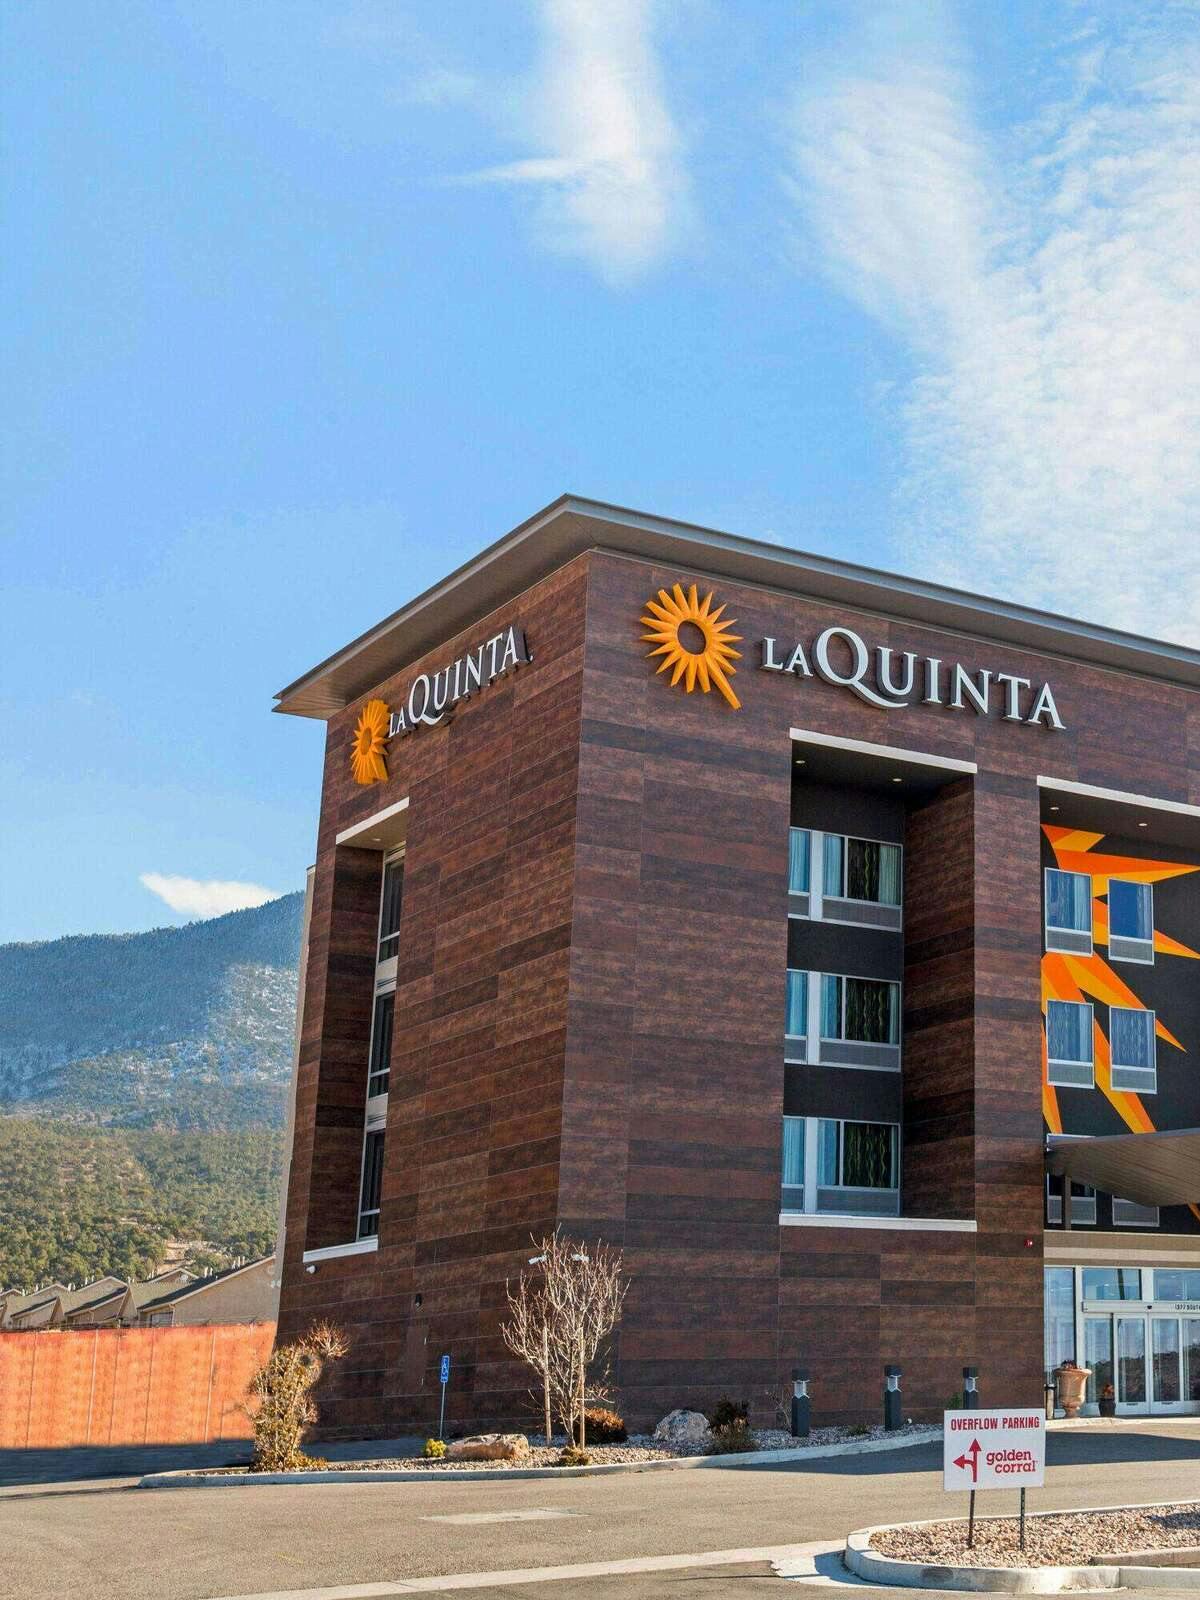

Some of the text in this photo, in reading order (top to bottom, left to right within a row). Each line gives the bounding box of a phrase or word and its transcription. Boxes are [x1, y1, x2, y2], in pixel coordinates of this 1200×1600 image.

[388, 626, 520, 738] LA QUINTA
[760, 626, 1067, 730] LA QUINTA
[950, 1416, 1040, 1431] OVERFLOW PARKING
[986, 1449, 1032, 1465] golden
[994, 1460, 1036, 1473] corral
